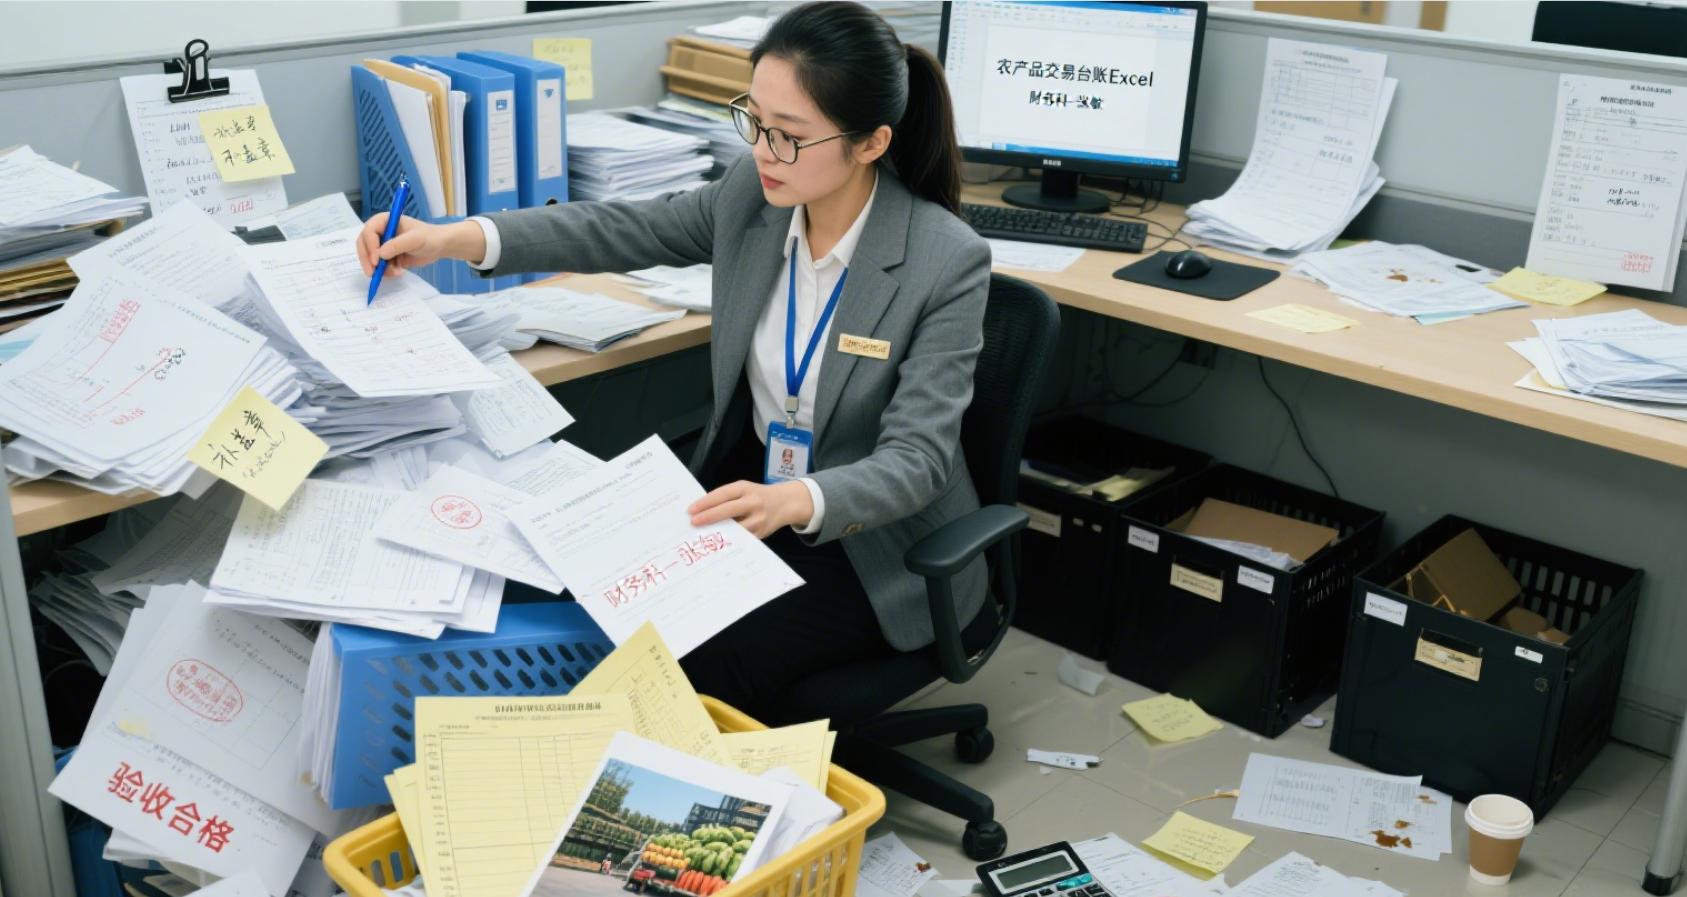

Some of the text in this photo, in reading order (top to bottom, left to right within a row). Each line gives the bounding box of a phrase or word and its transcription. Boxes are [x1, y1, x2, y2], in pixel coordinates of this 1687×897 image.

[996, 58, 1154, 87] 农产品交易台账Excel
[108, 761, 235, 853] 验收合格
